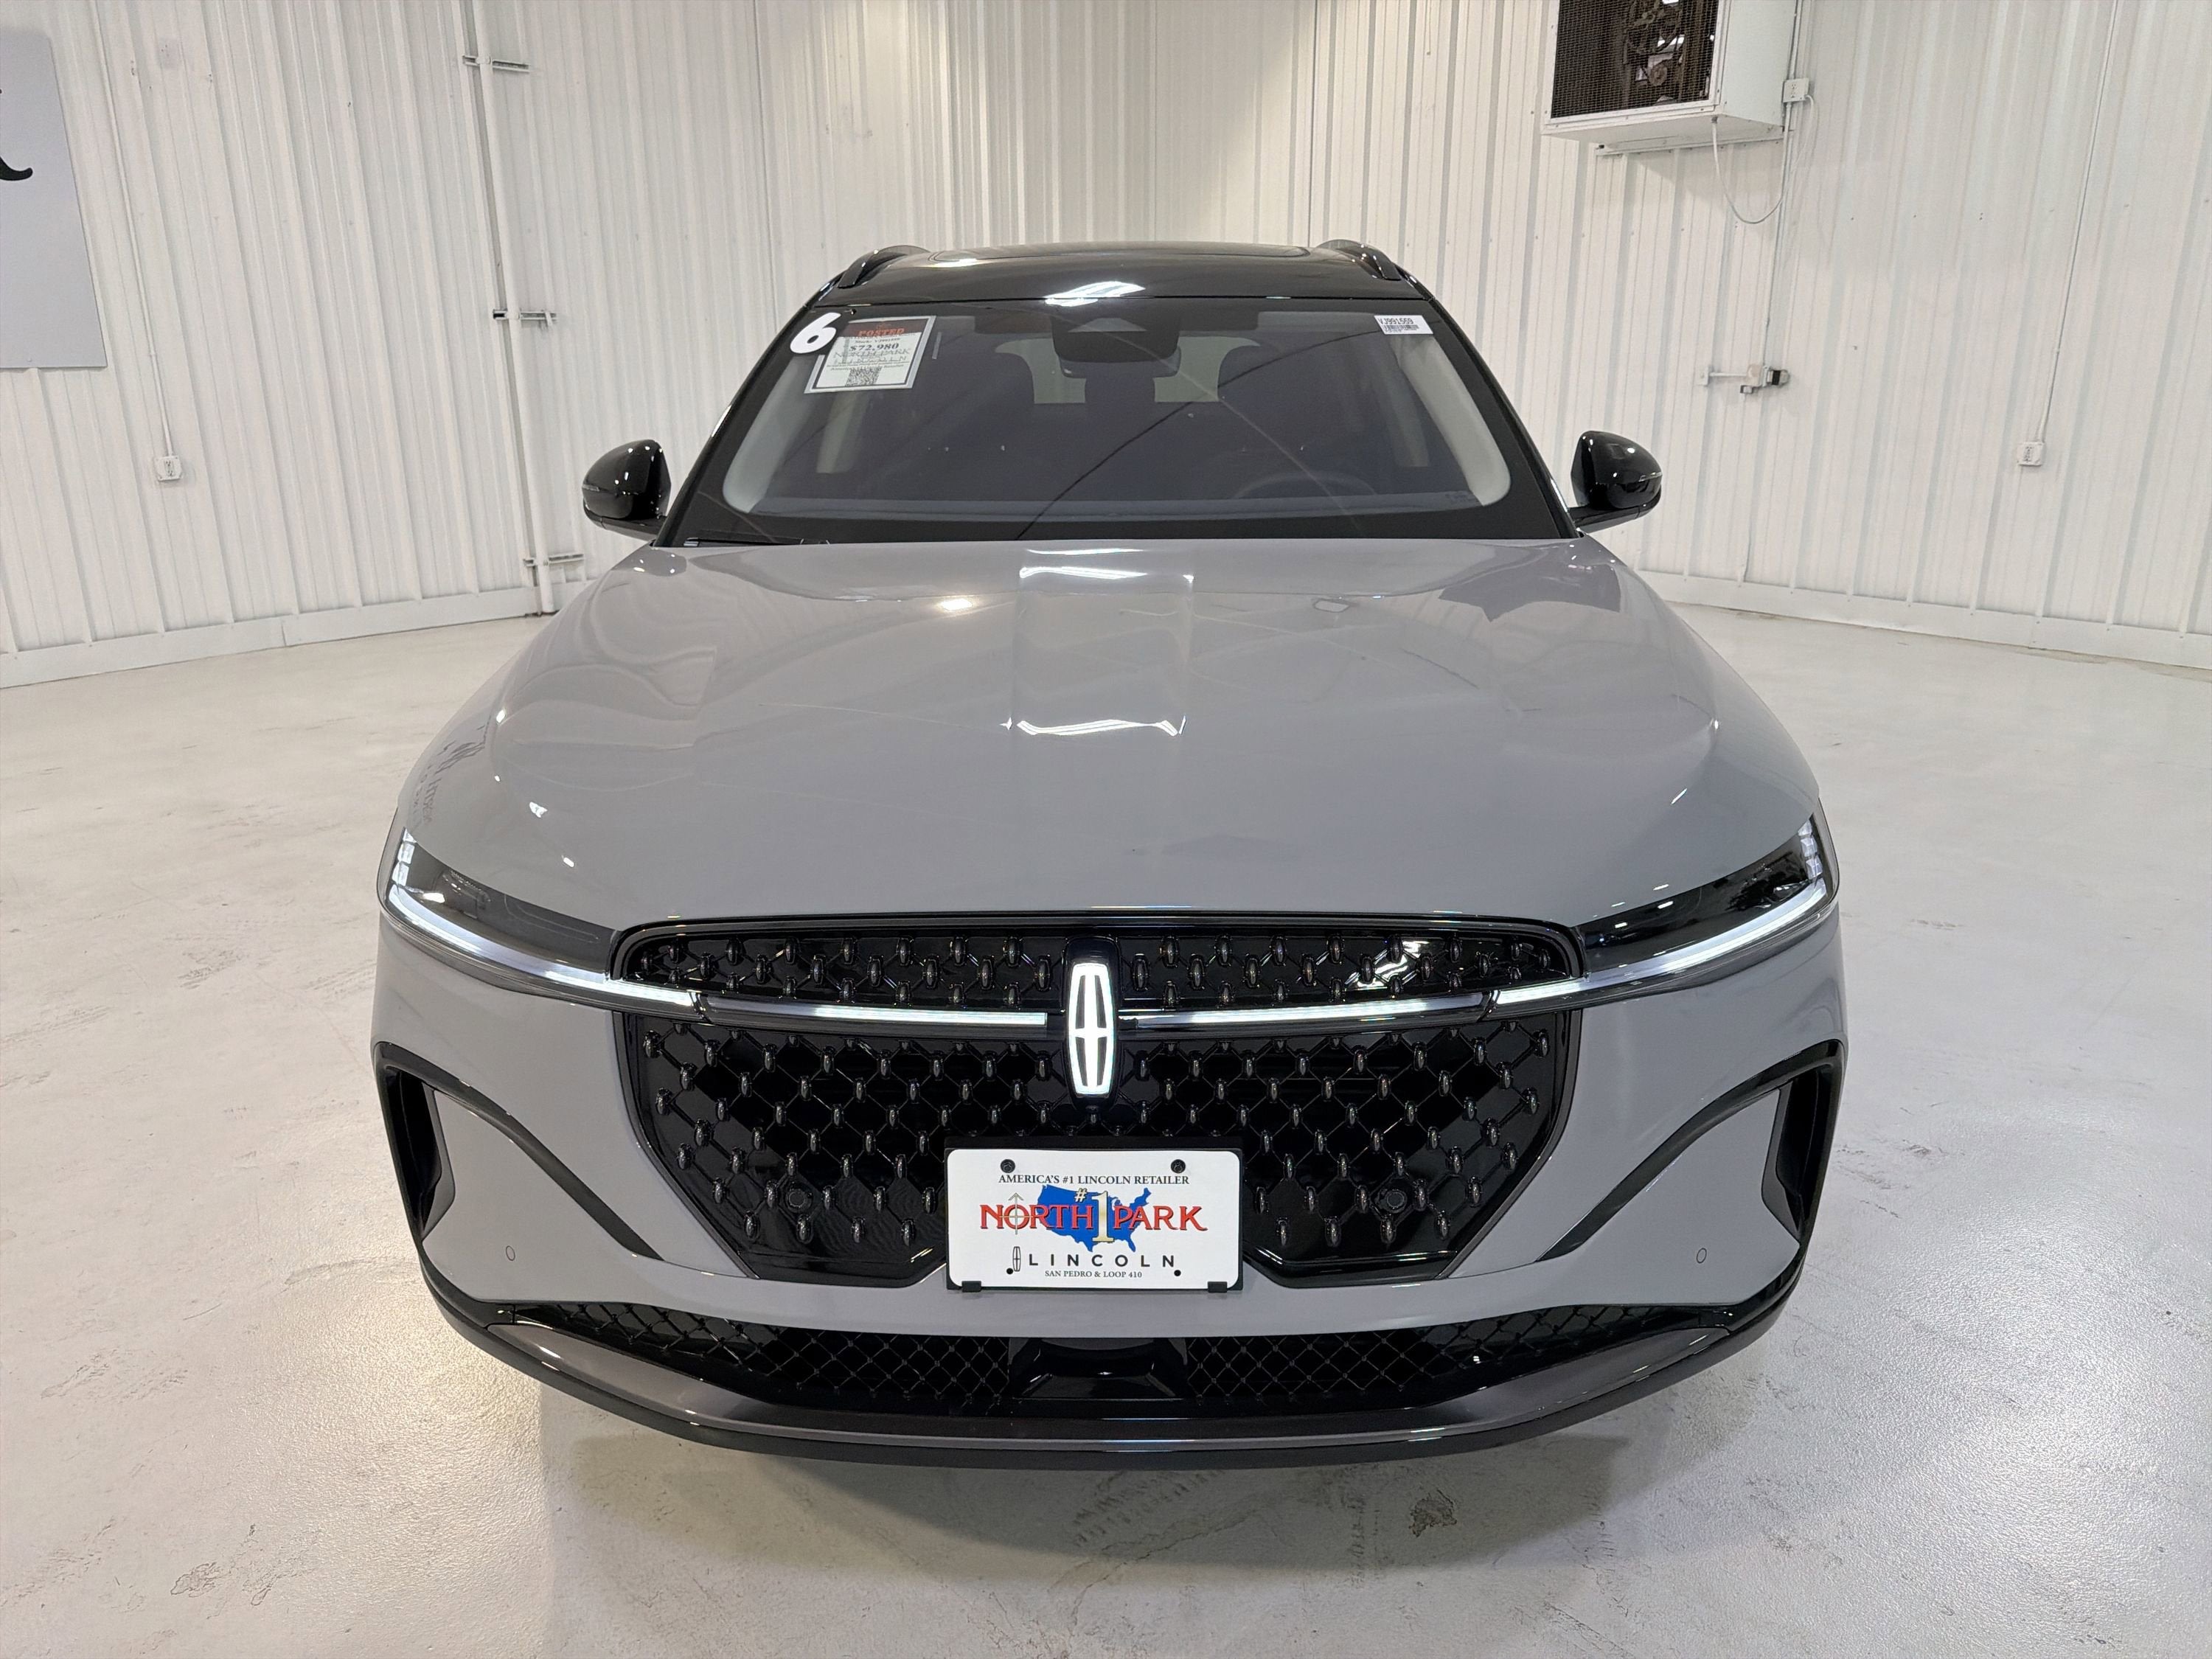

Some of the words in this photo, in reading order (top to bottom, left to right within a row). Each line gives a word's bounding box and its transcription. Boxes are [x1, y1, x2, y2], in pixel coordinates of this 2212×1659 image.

[790, 312, 841, 354] 6
[998, 1175, 1060, 1183] AMERICA'S
[1062, 1175, 1074, 1184] #1
[1077, 1175, 1130, 1184] LINCOLN
[1134, 1175, 1189, 1184] RETAILER
[979, 1204, 1094, 1230] NORTH
[1113, 1205, 1208, 1231] PARK
[1029, 1253, 1175, 1267] LINCOLN
